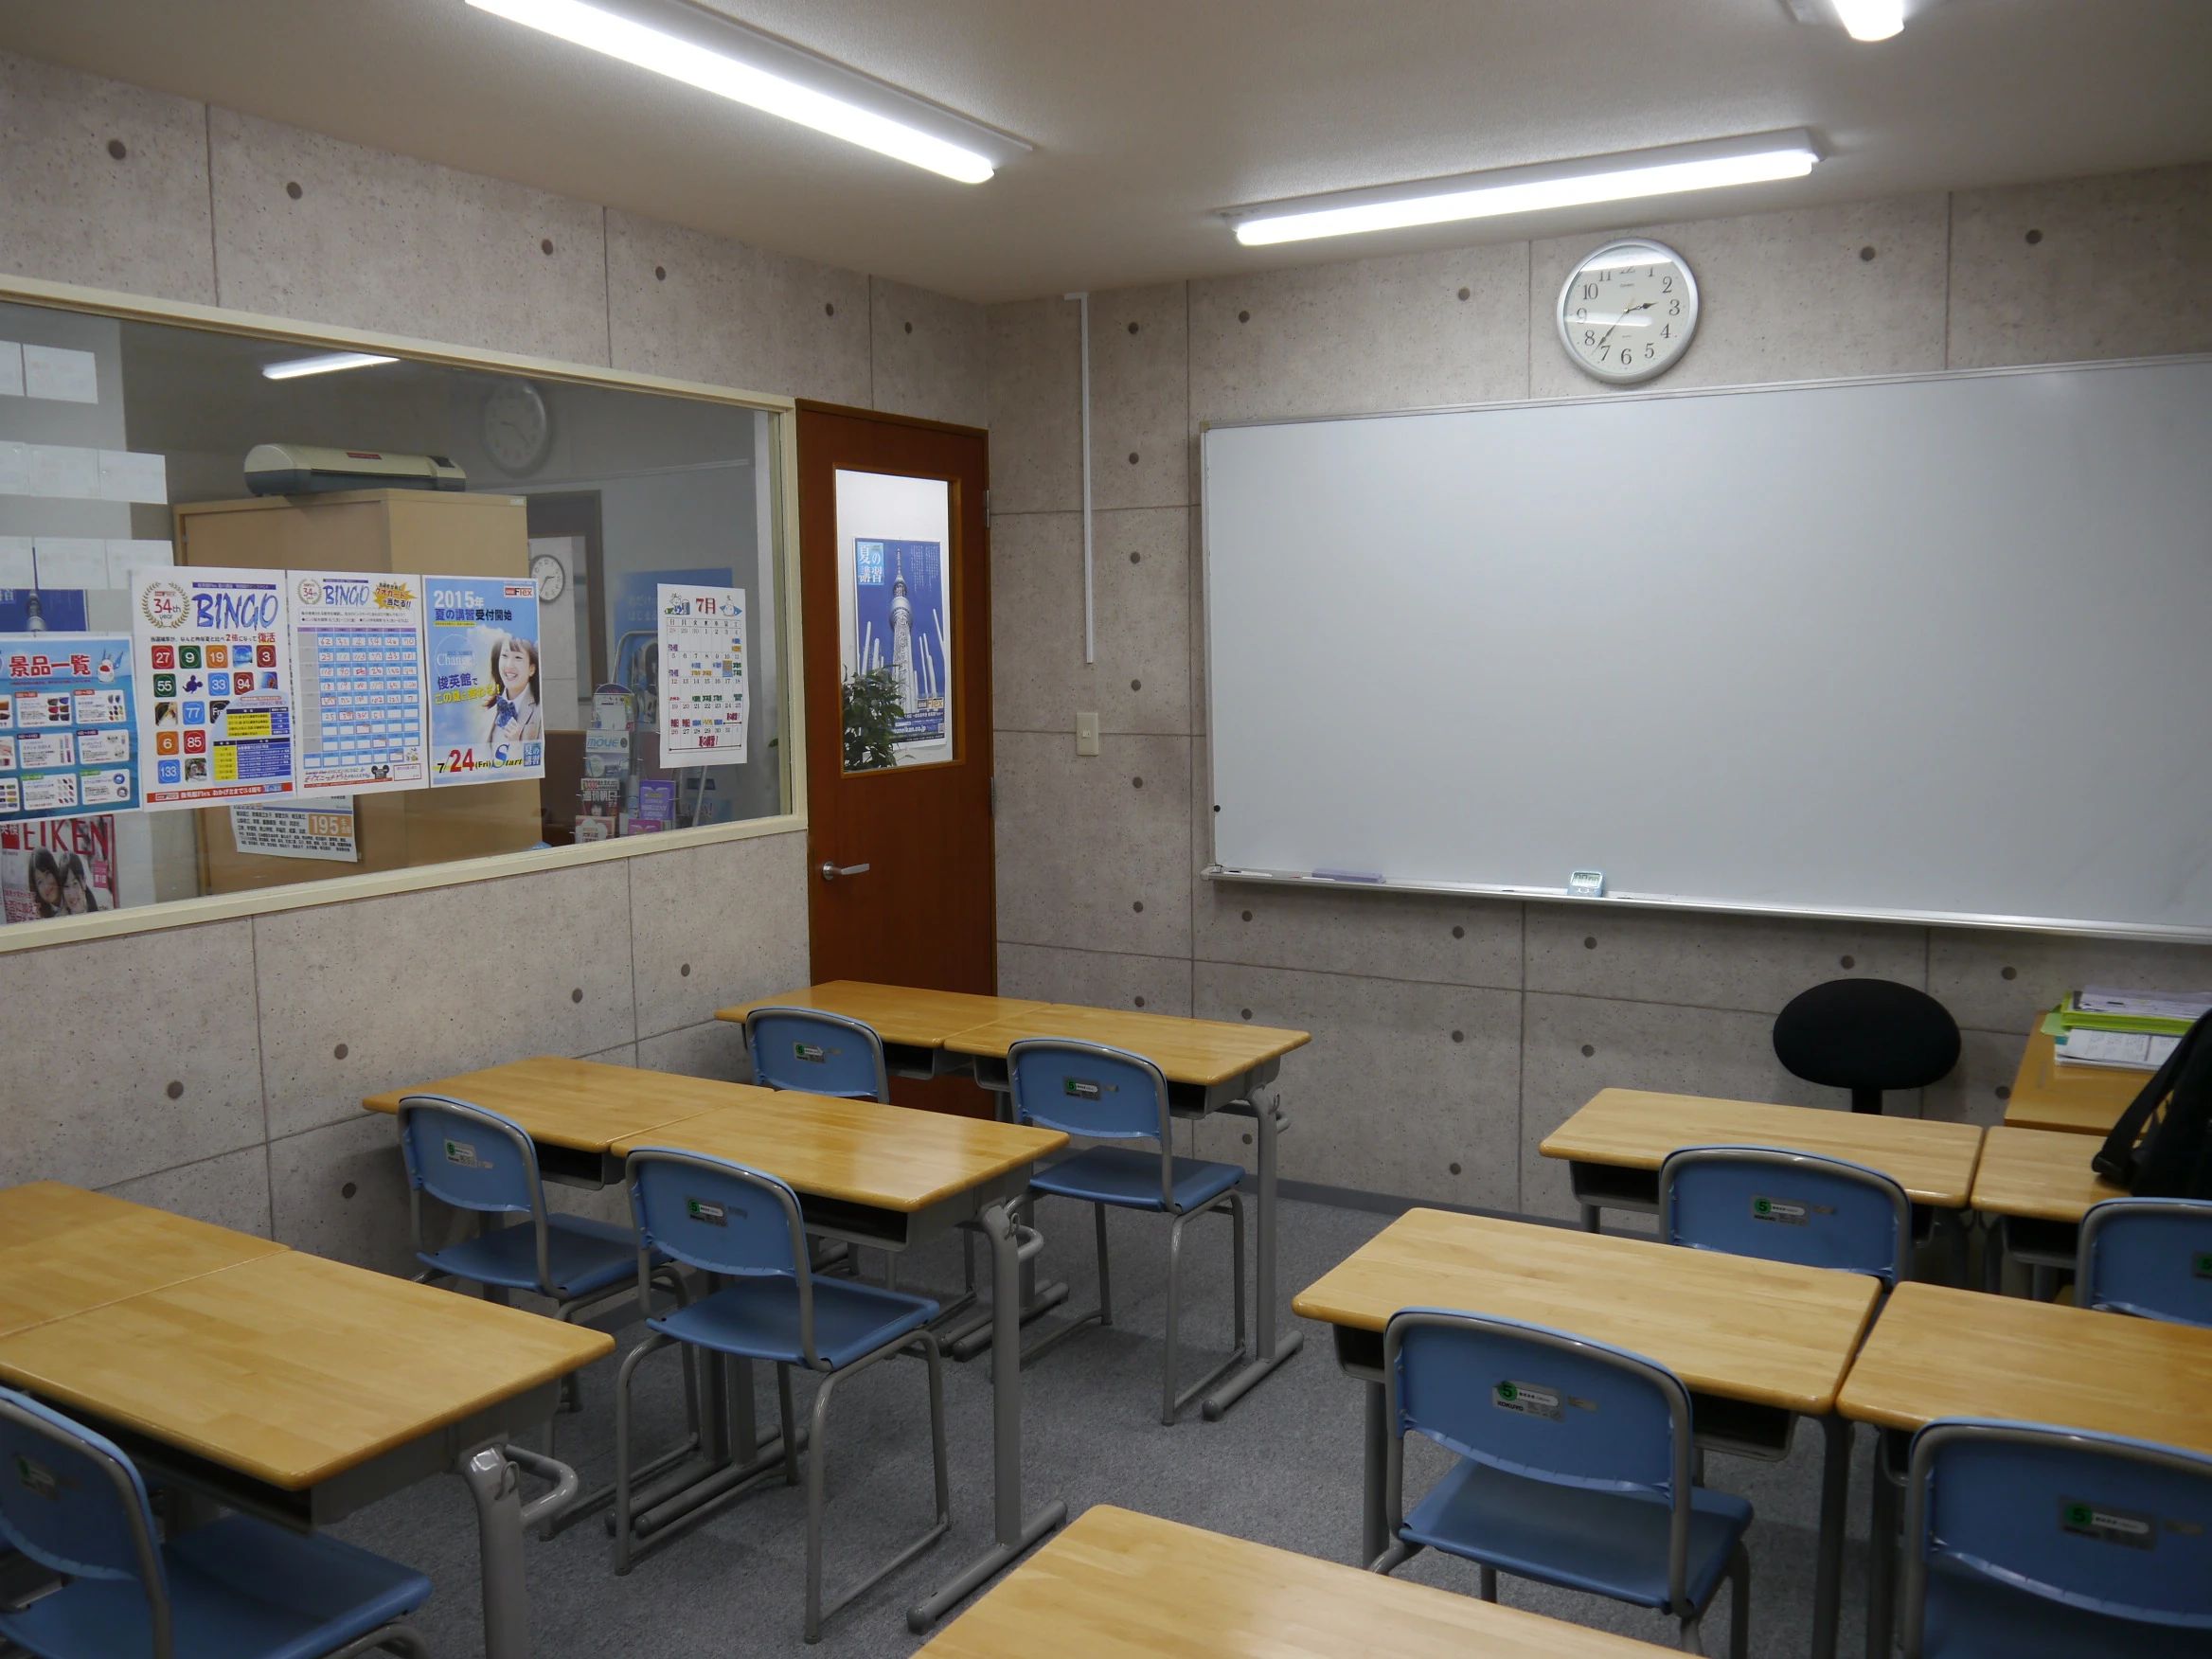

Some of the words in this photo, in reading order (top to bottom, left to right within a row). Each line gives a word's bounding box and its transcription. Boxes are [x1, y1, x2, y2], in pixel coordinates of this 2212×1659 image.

[1582, 283, 1598, 300] 10
[1662, 276, 1672, 294] 2
[1668, 299, 1681, 316] 3
[1576, 308, 1587, 324] 9
[1584, 330, 1596, 346] 8
[1660, 323, 1671, 339] 4
[1600, 346, 1611, 362] 7
[1620, 348, 1632, 365] 6
[1644, 343, 1654, 358] 5
[859, 544, 882, 565] 夏の
[323, 585, 370, 607] BINGO
[434, 590, 485, 608] 2015年
[153, 598, 181, 614] 34th
[191, 592, 278, 631] BINGO
[696, 598, 716, 615] 7月
[9, 654, 91, 677] 景品一覧
[155, 653, 169, 663] 27
[186, 652, 195, 664] 9
[210, 652, 224, 663] 19
[262, 652, 271, 662] 3
[157, 681, 172, 691] 55
[212, 680, 226, 690] 33
[237, 679, 251, 689] 94
[186, 707, 201, 719] 77
[163, 739, 172, 749] 6
[187, 737, 202, 748] 85
[160, 767, 177, 777] 133
[311, 815, 339, 834] 195
[1502, 1383, 1512, 1399] 5
